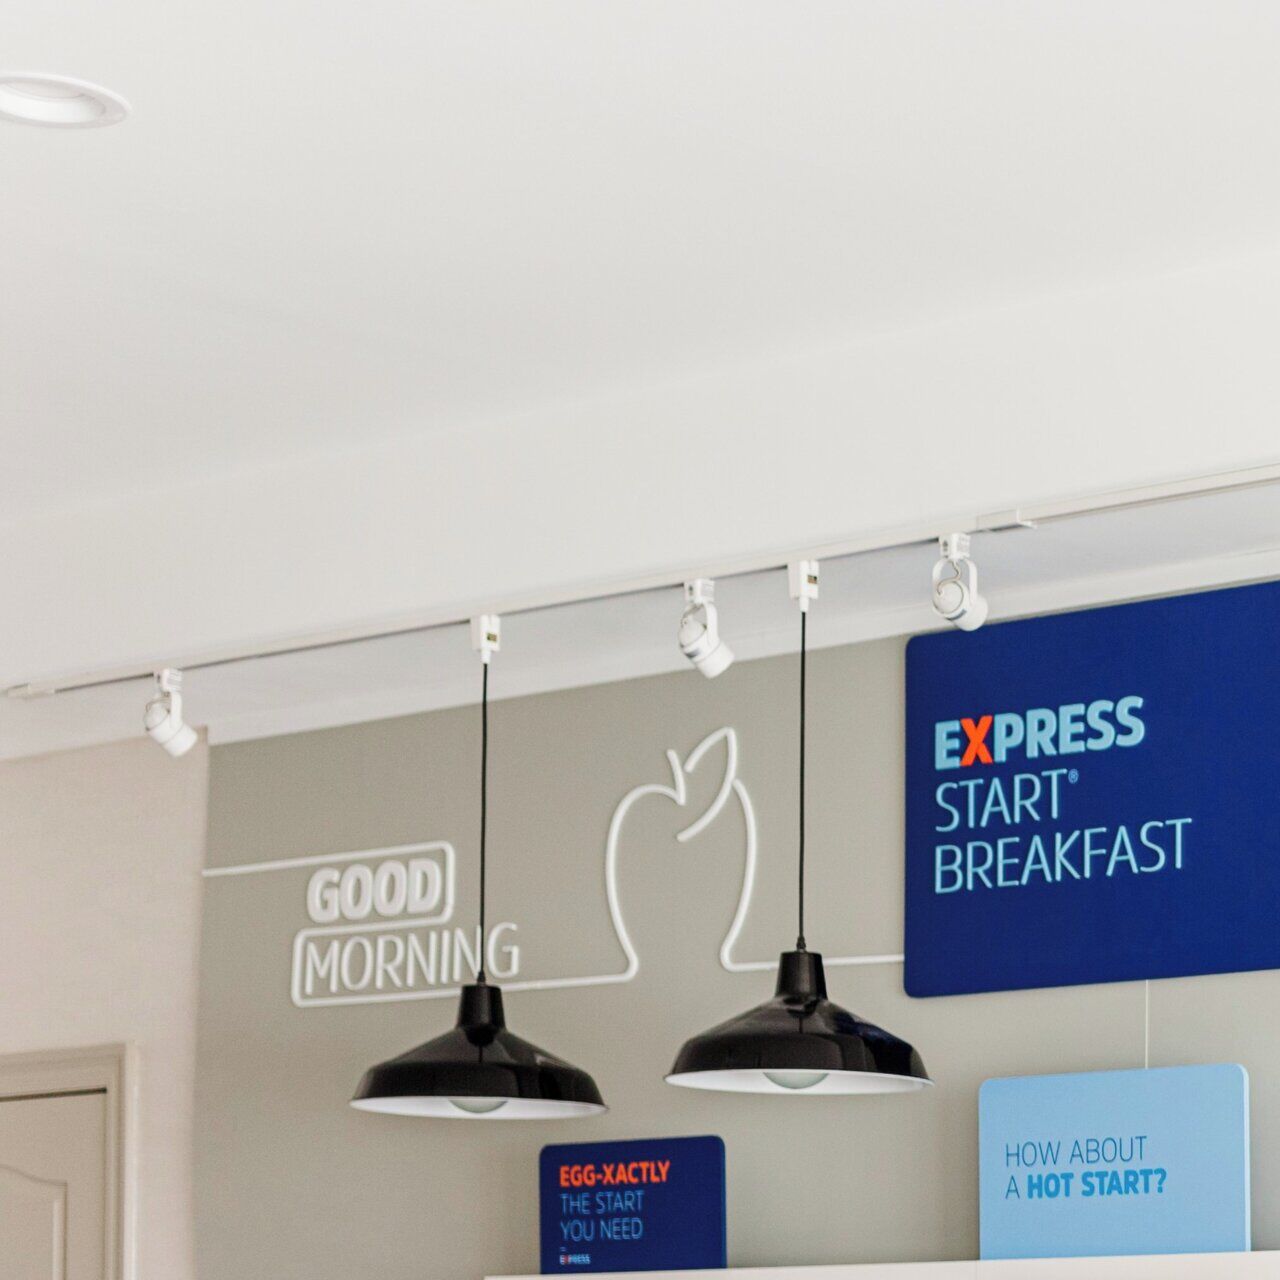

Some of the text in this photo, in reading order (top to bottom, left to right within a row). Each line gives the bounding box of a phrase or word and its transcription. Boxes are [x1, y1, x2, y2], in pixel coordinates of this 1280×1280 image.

[935, 696, 1145, 770] EXPRESS
[935, 818, 1192, 894] BREAKFAST
[307, 858, 442, 923] GOOD
[305, 922, 519, 995] MORNING
[1005, 1136, 1147, 1167] HOW ABOUT
[560, 1161, 670, 1187] EGG-XACTLY
[1005, 1168, 1167, 1200] A HOT START?
[560, 1190, 644, 1214] THE START
[560, 1217, 643, 1241] YOU NEED
